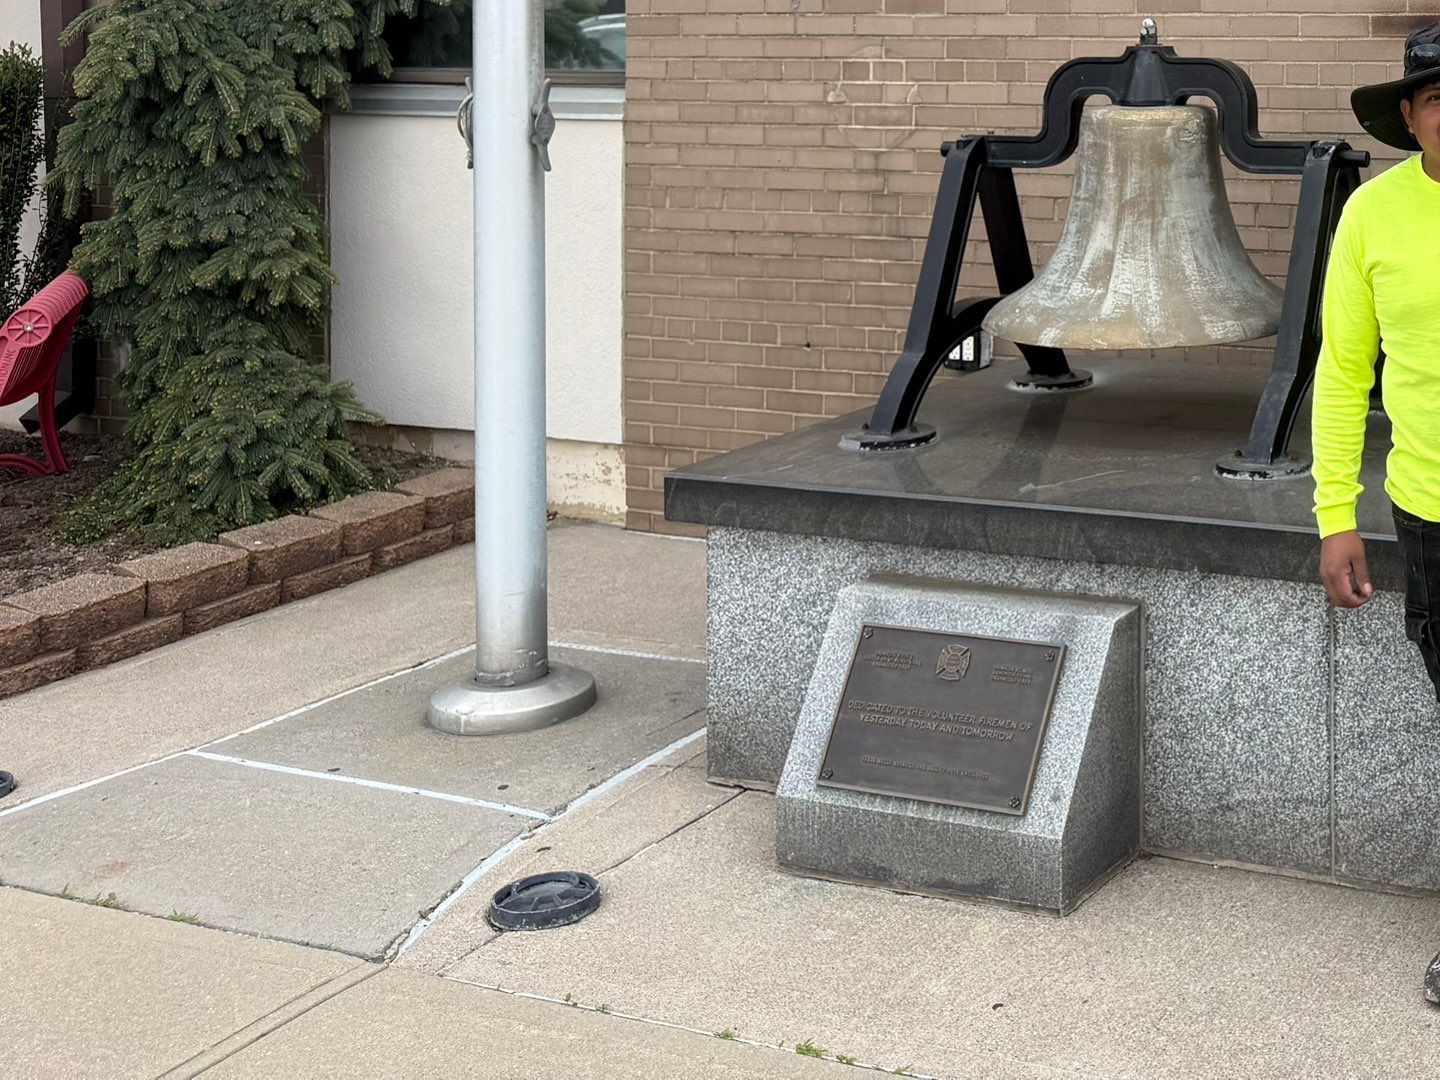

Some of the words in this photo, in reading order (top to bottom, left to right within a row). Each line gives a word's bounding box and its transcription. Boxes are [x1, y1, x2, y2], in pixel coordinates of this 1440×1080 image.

[847, 699, 893, 713] DEDICATED
[894, 705, 907, 715] TO
[907, 706, 925, 717] THE
[927, 710, 976, 725] VOLUNTEER
[979, 716, 1018, 729] FIREMEN
[1020, 721, 1033, 732] OF
[860, 713, 907, 726] YESTERDAY
[909, 718, 938, 732] TODAY
[939, 723, 959, 734] AND
[961, 725, 1015, 741] TOMORROW
